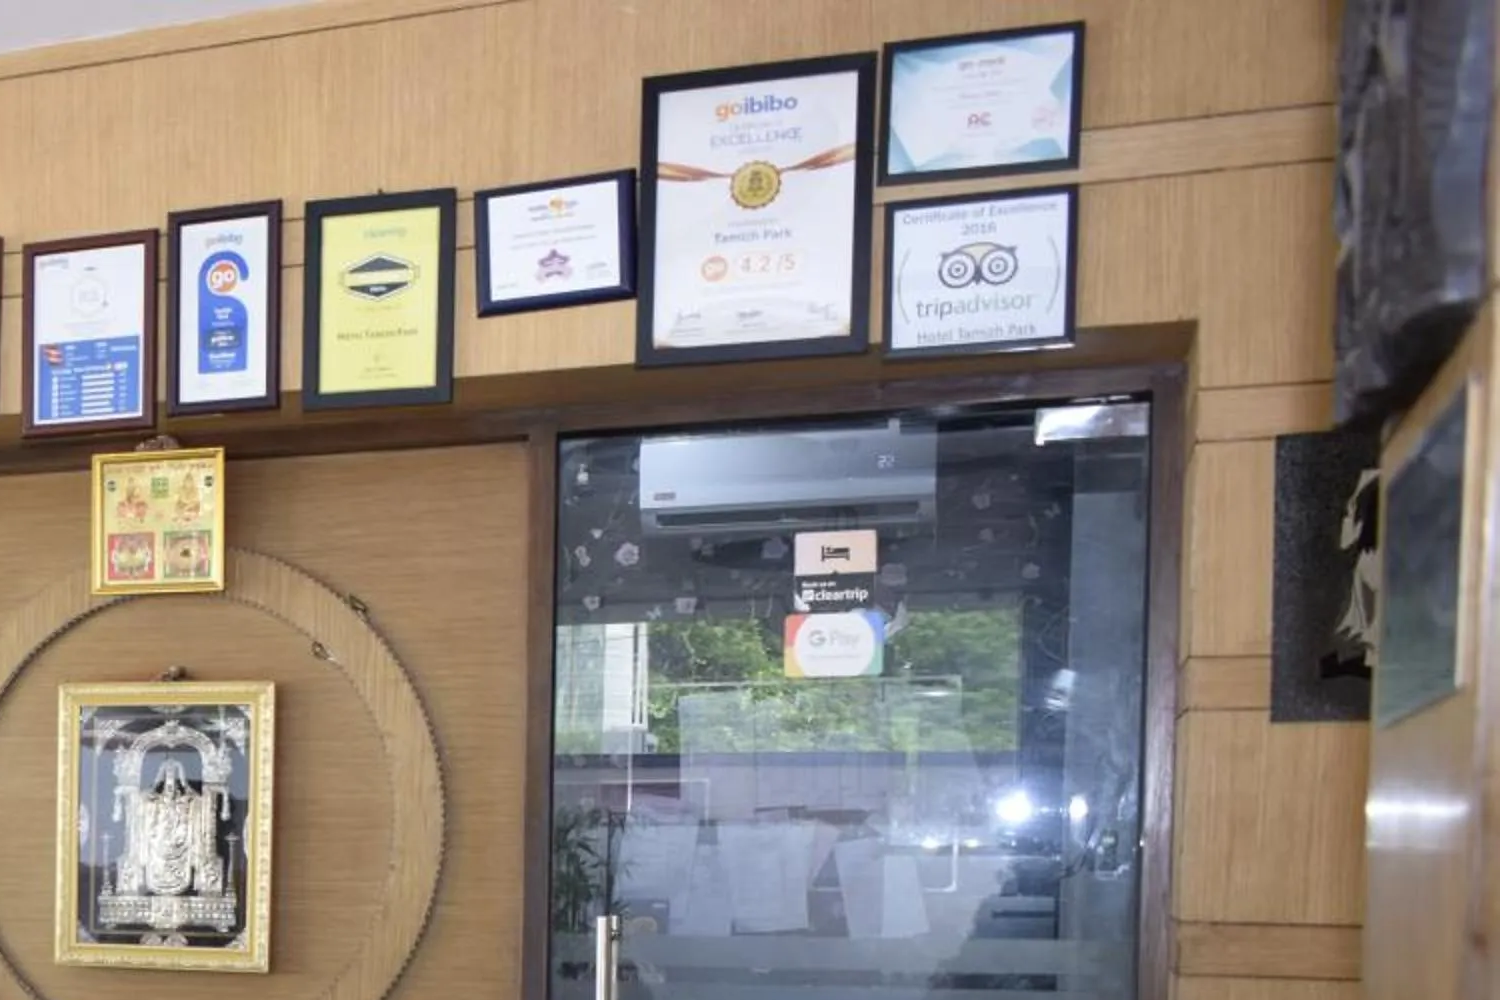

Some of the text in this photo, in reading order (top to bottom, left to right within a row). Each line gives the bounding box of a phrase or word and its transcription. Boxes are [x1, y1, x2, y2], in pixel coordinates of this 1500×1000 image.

[715, 94, 798, 121] goibibo
[710, 126, 803, 148] EXCELLENCE
[903, 201, 1058, 226] Certificate of Excellence
[763, 228, 793, 241] Park
[211, 269, 236, 290] go
[916, 291, 1036, 321] tripadvisor
[917, 326, 953, 345] Hotel
[1008, 321, 1037, 336] Park
[815, 587, 869, 603] cleartrip
